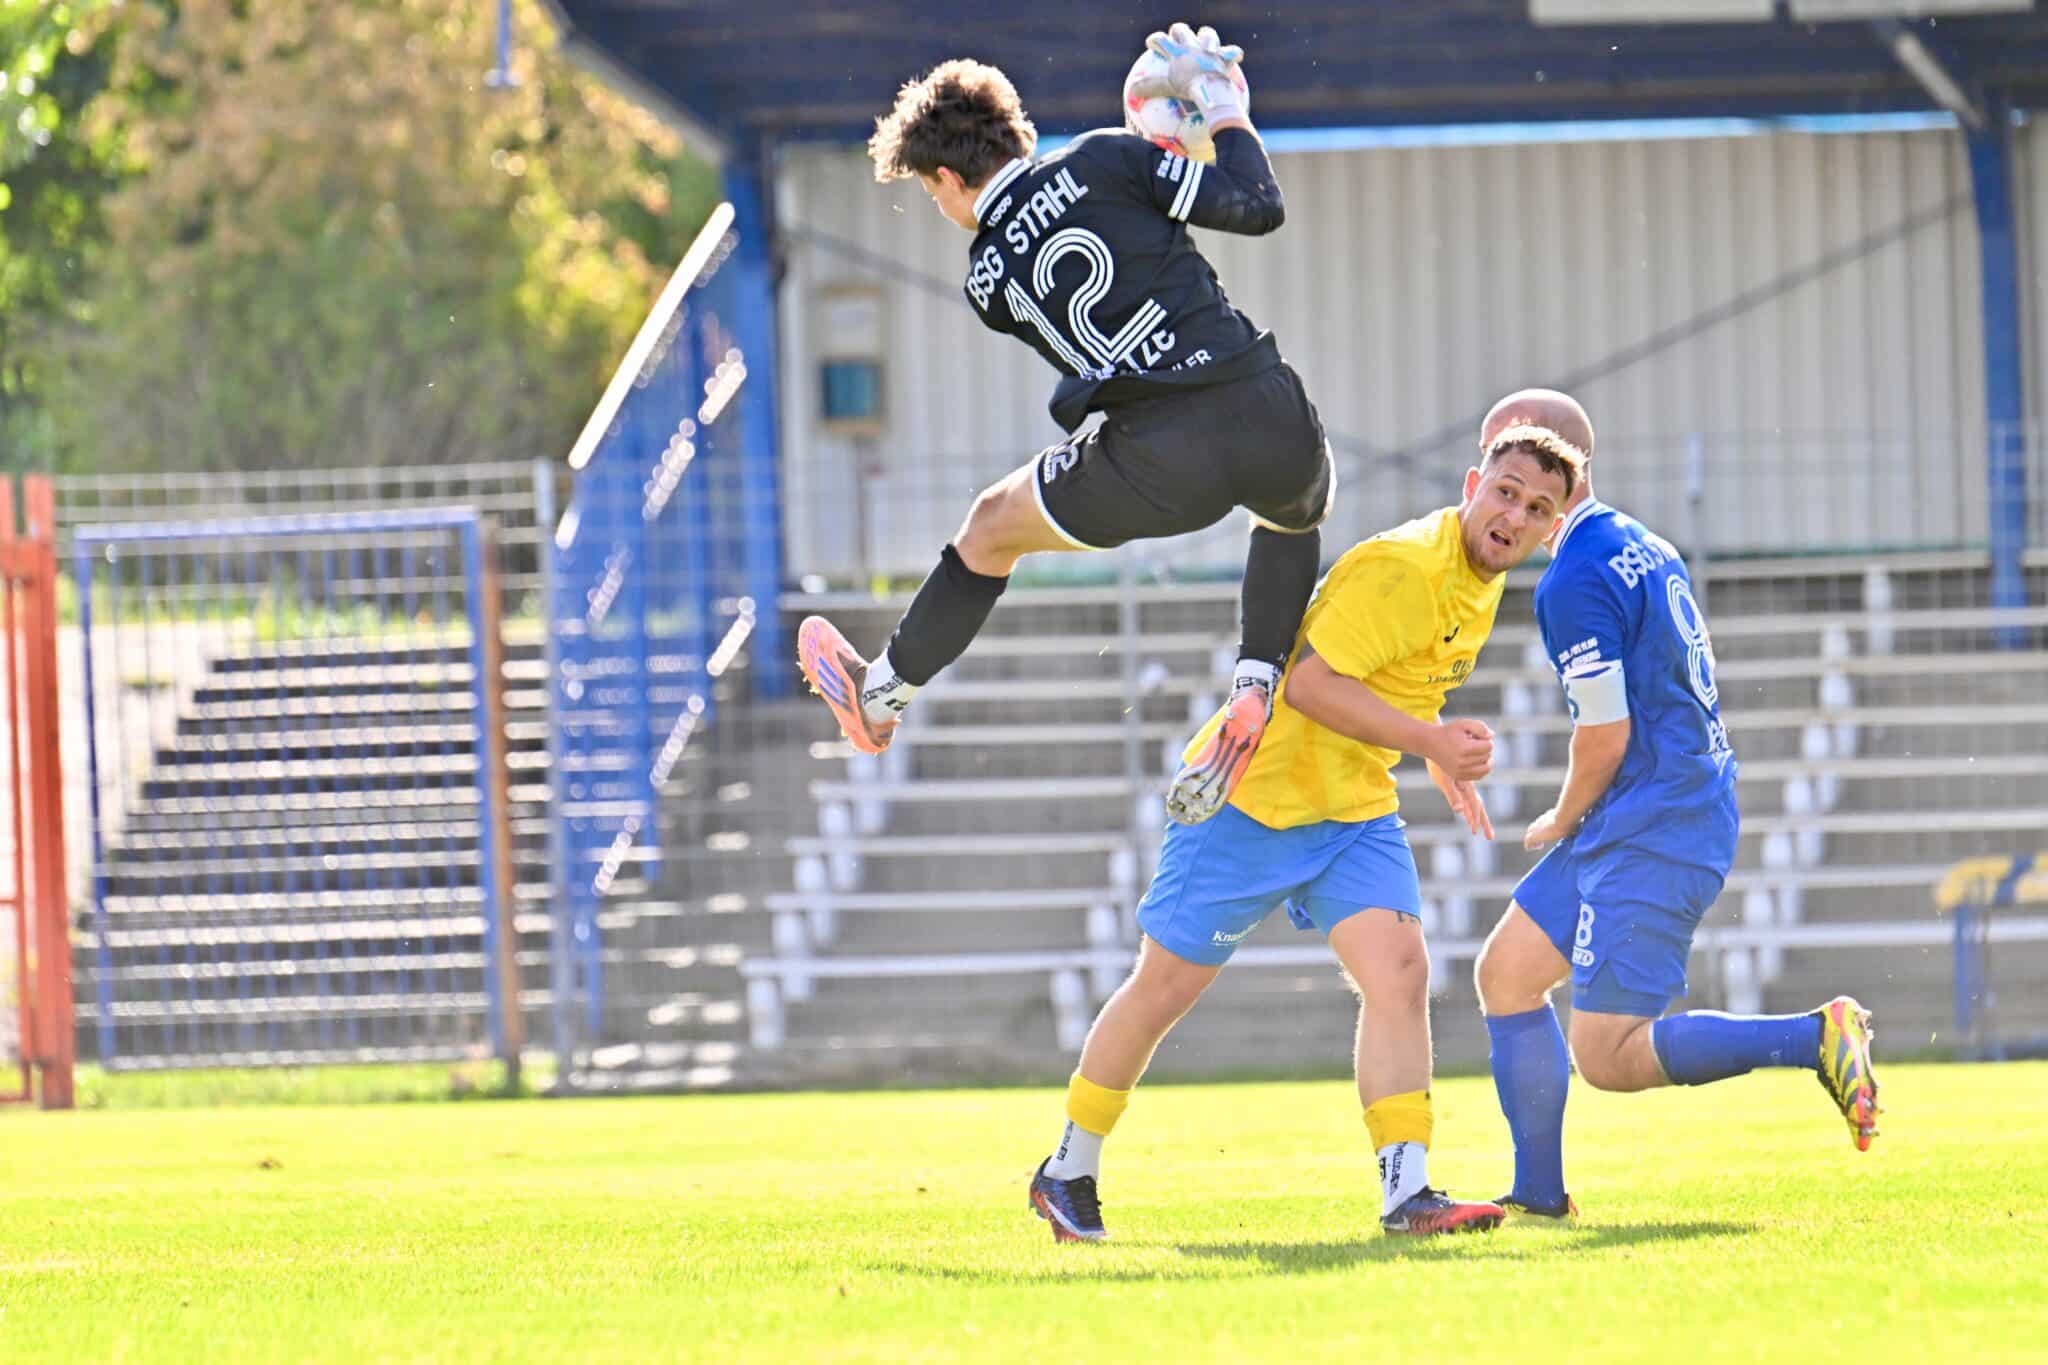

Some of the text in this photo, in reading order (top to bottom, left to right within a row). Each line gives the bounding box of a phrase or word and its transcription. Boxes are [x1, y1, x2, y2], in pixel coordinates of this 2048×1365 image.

[965, 245, 1005, 312] BSG
[1005, 166, 1089, 255] STAHL
[1004, 227, 1168, 380] 12
[1666, 573, 1718, 711] 8
[1575, 903, 1595, 947] 8
